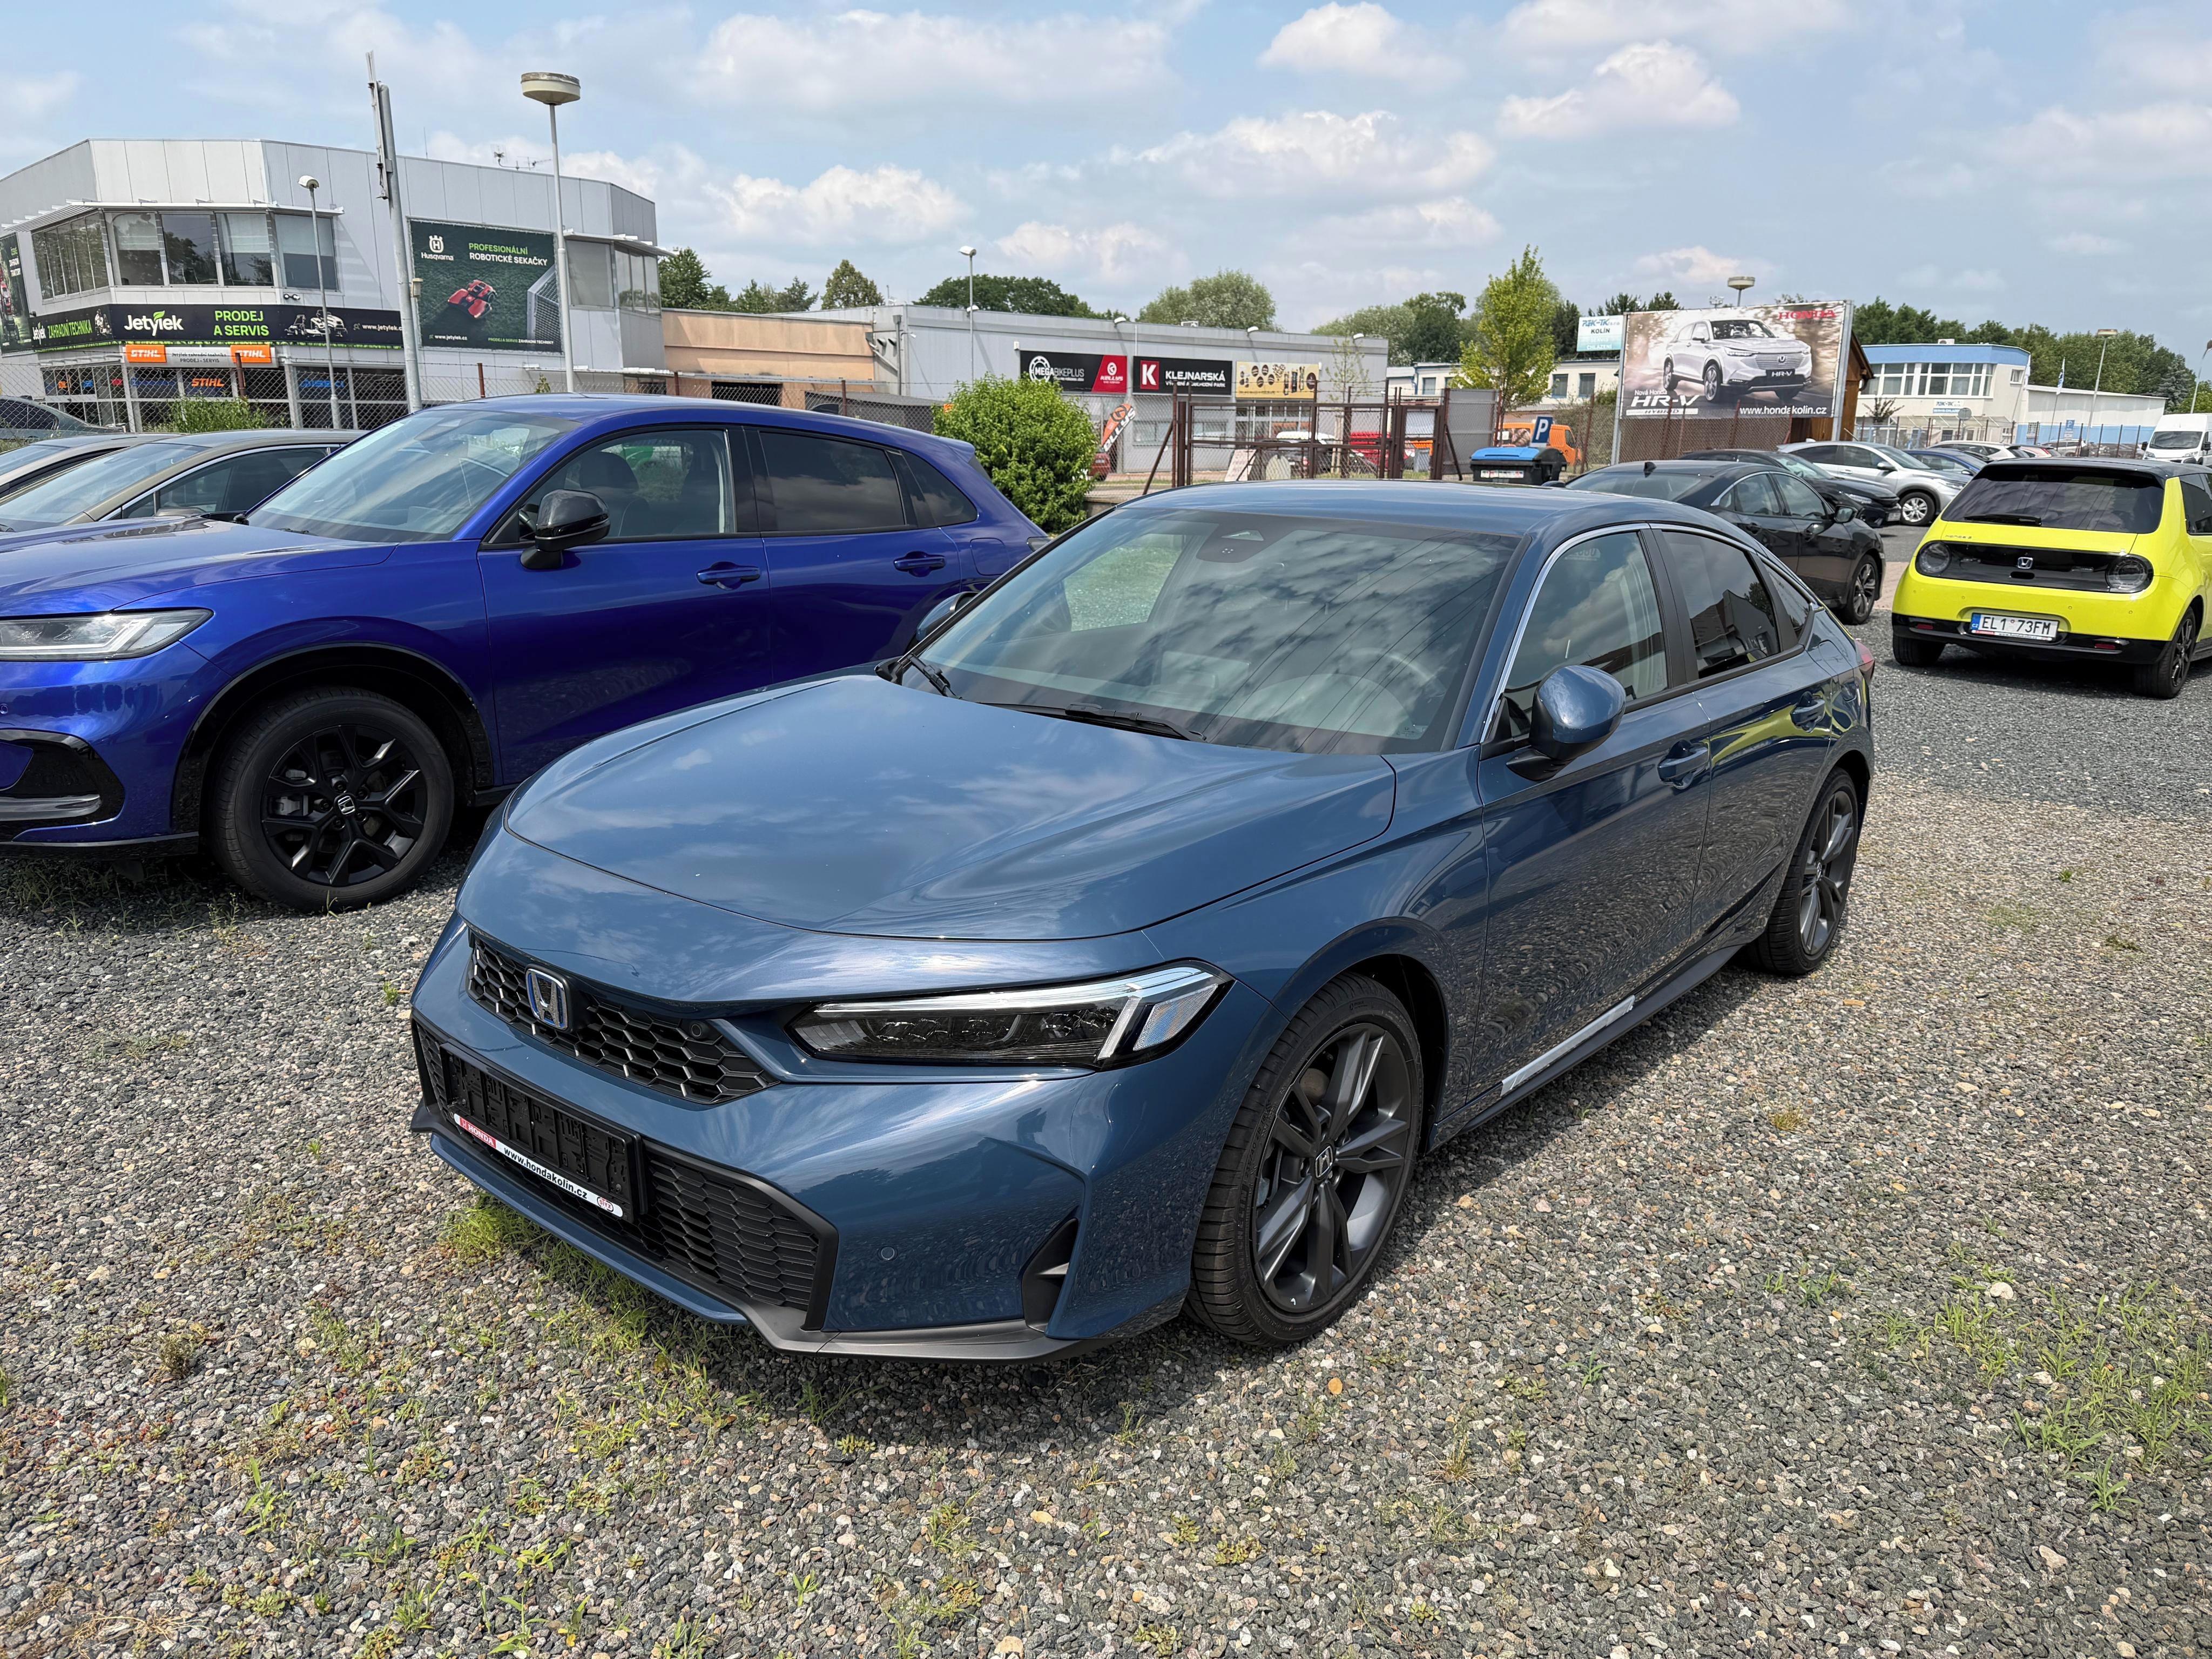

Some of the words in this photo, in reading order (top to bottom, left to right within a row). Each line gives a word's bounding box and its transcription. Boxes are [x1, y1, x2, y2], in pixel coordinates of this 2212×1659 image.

[469, 242, 528, 255] PROFESIONÁLNÍ
[421, 252, 454, 261] Husqvarna
[469, 252, 512, 264] ROBOTICKÉ
[514, 256, 548, 266] SEKAČKY
[215, 311, 264, 322] PRODEJ
[1778, 309, 1836, 320] HONDA
[48, 319, 70, 339] ZAHRADNÍ
[70, 319, 93, 336] TECHNIKA
[124, 312, 184, 336] Jetylek
[362, 324, 402, 332] www.jetylek.c
[214, 325, 222, 336] A
[224, 325, 269, 336] SERVIS
[131, 349, 161, 358] STIHL
[1142, 364, 1157, 386] K
[1165, 370, 1225, 382] KLEJNARSKÁ
[191, 377, 225, 387] STIHL
[1631, 395, 1700, 407] HR-V
[1739, 405, 1827, 415] www.hondakolin.cz
[1535, 419, 1549, 440] P
[1982, 617, 2007, 631] EL1
[2017, 620, 2052, 635] 73FM
[468, 1123, 495, 1147] HONDA
[504, 1147, 588, 1199] www.hondakolin.cz
